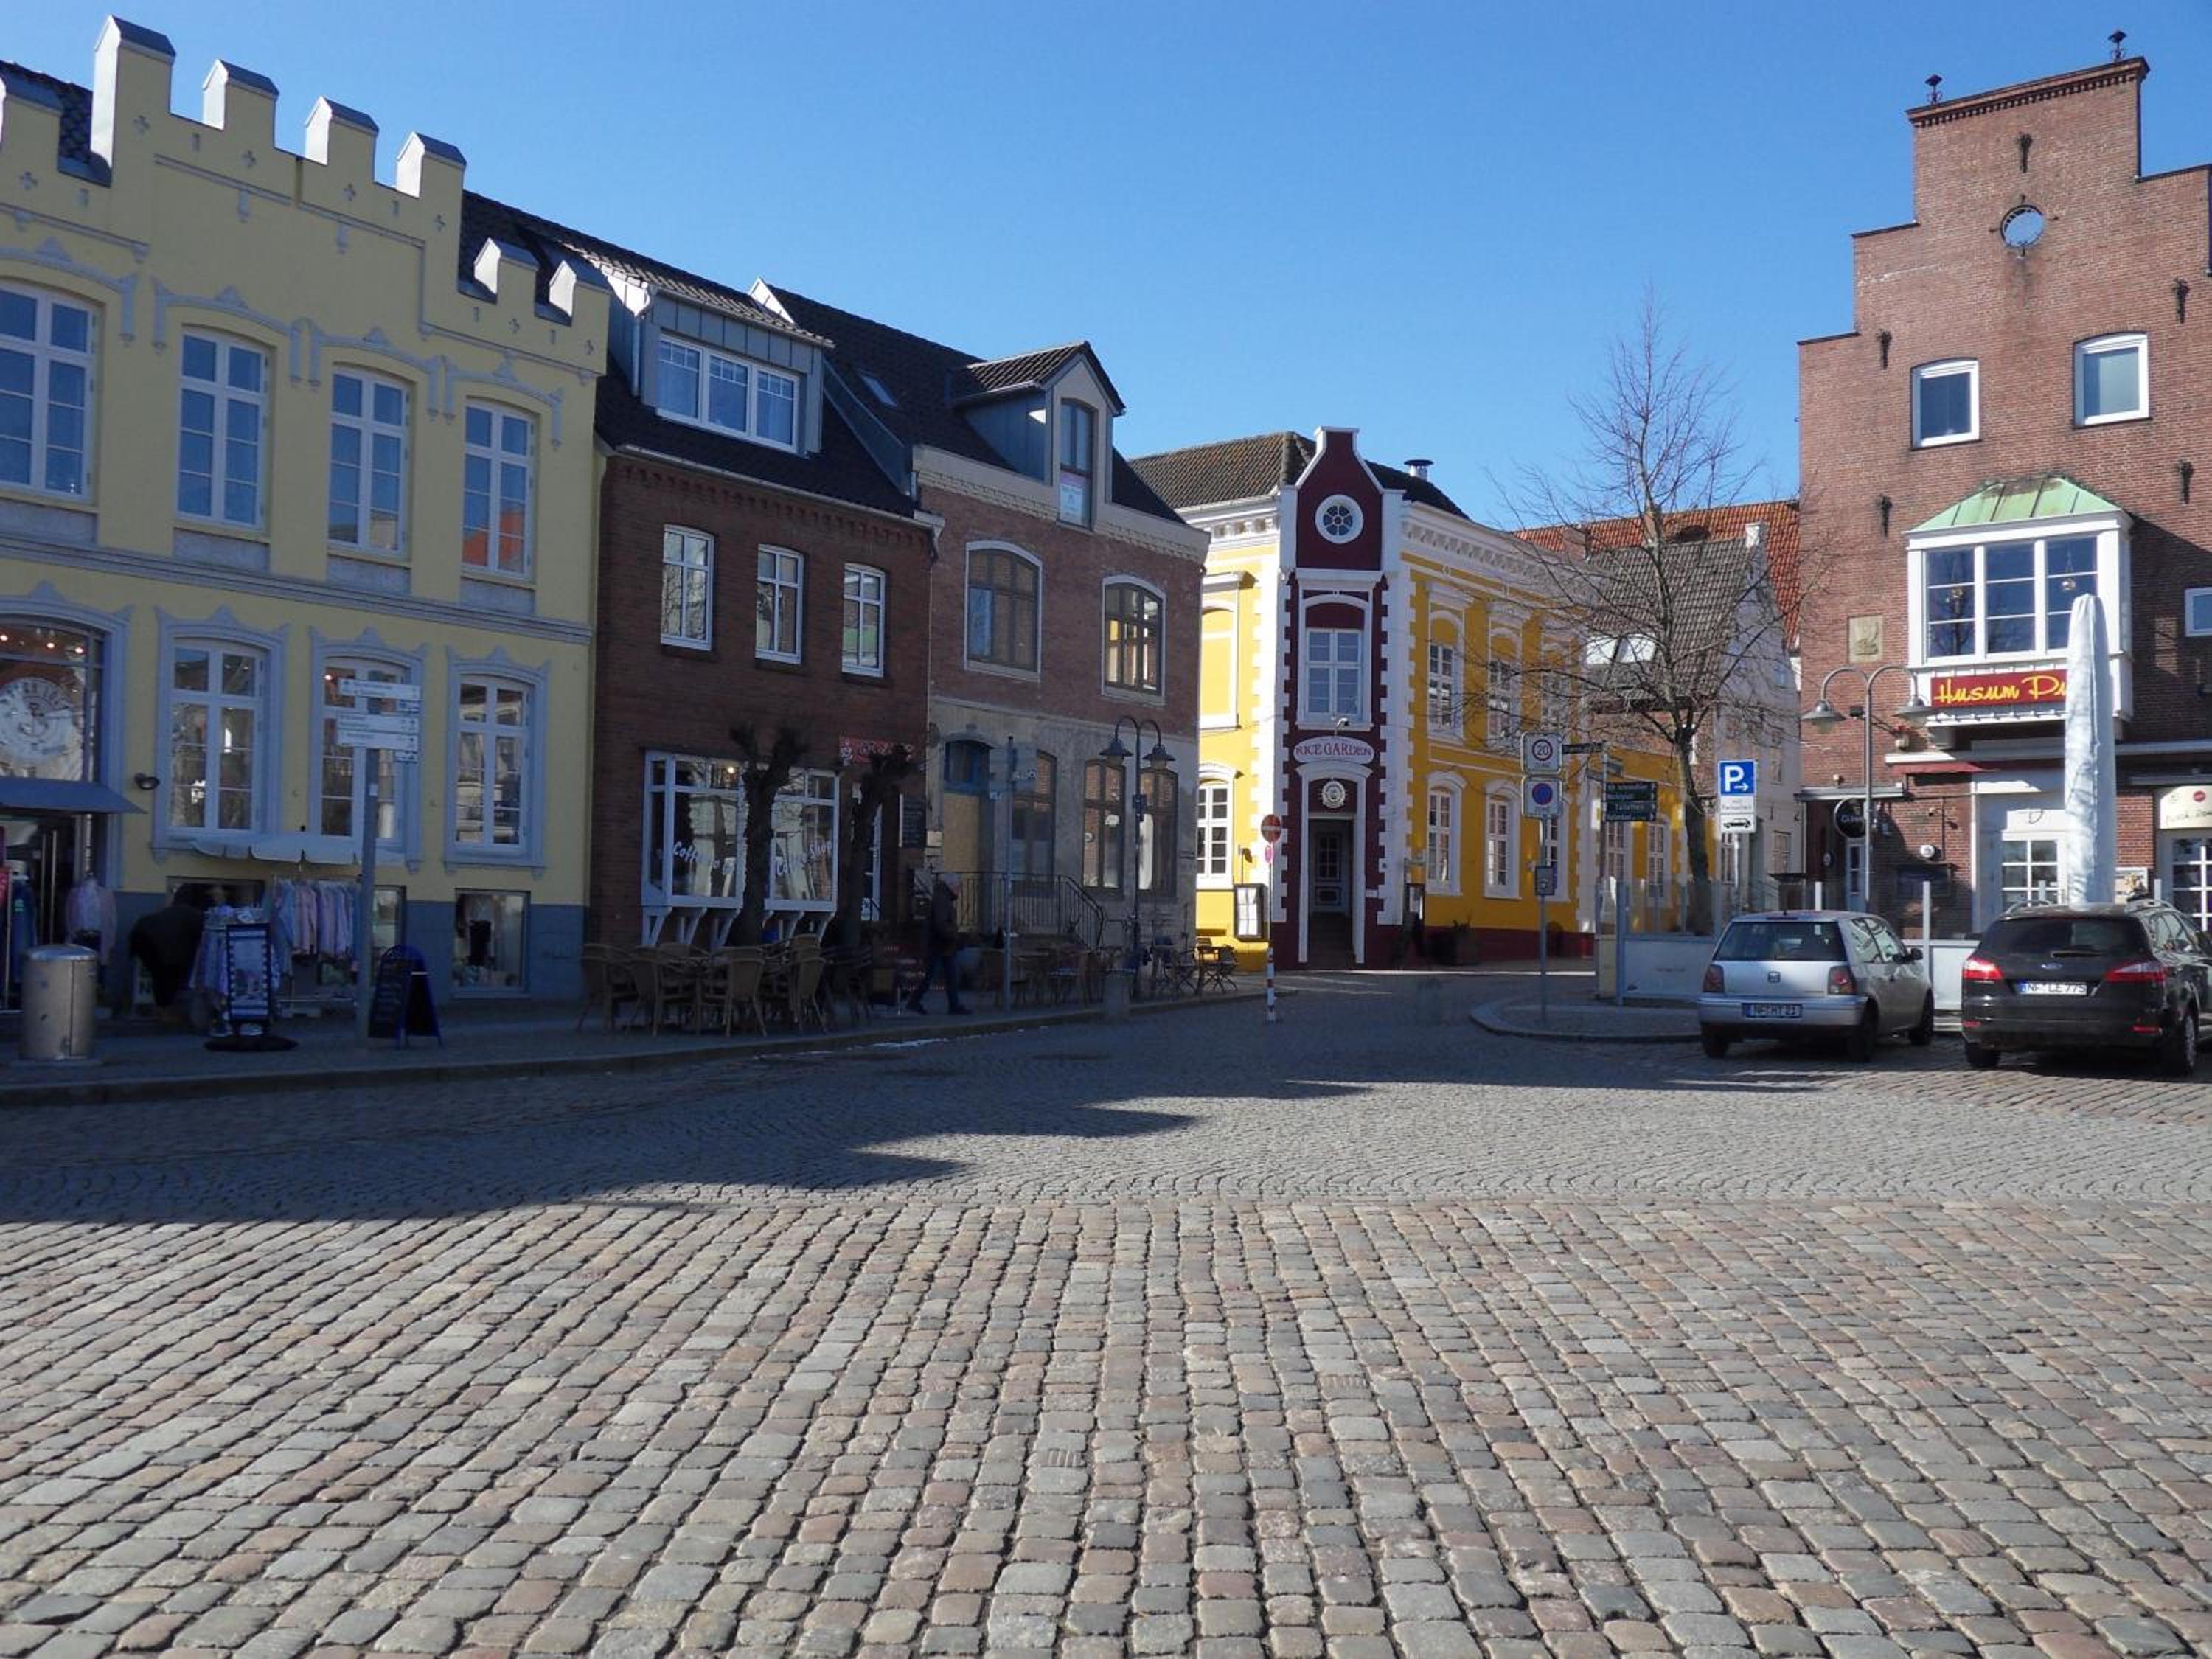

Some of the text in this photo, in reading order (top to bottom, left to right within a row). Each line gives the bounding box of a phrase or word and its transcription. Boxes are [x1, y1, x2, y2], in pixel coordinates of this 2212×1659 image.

[1934, 678, 2020, 704] Husum
[1324, 742, 1372, 756] GARDEN
[1537, 743, 1549, 756] 20
[1725, 765, 1745, 793] P
